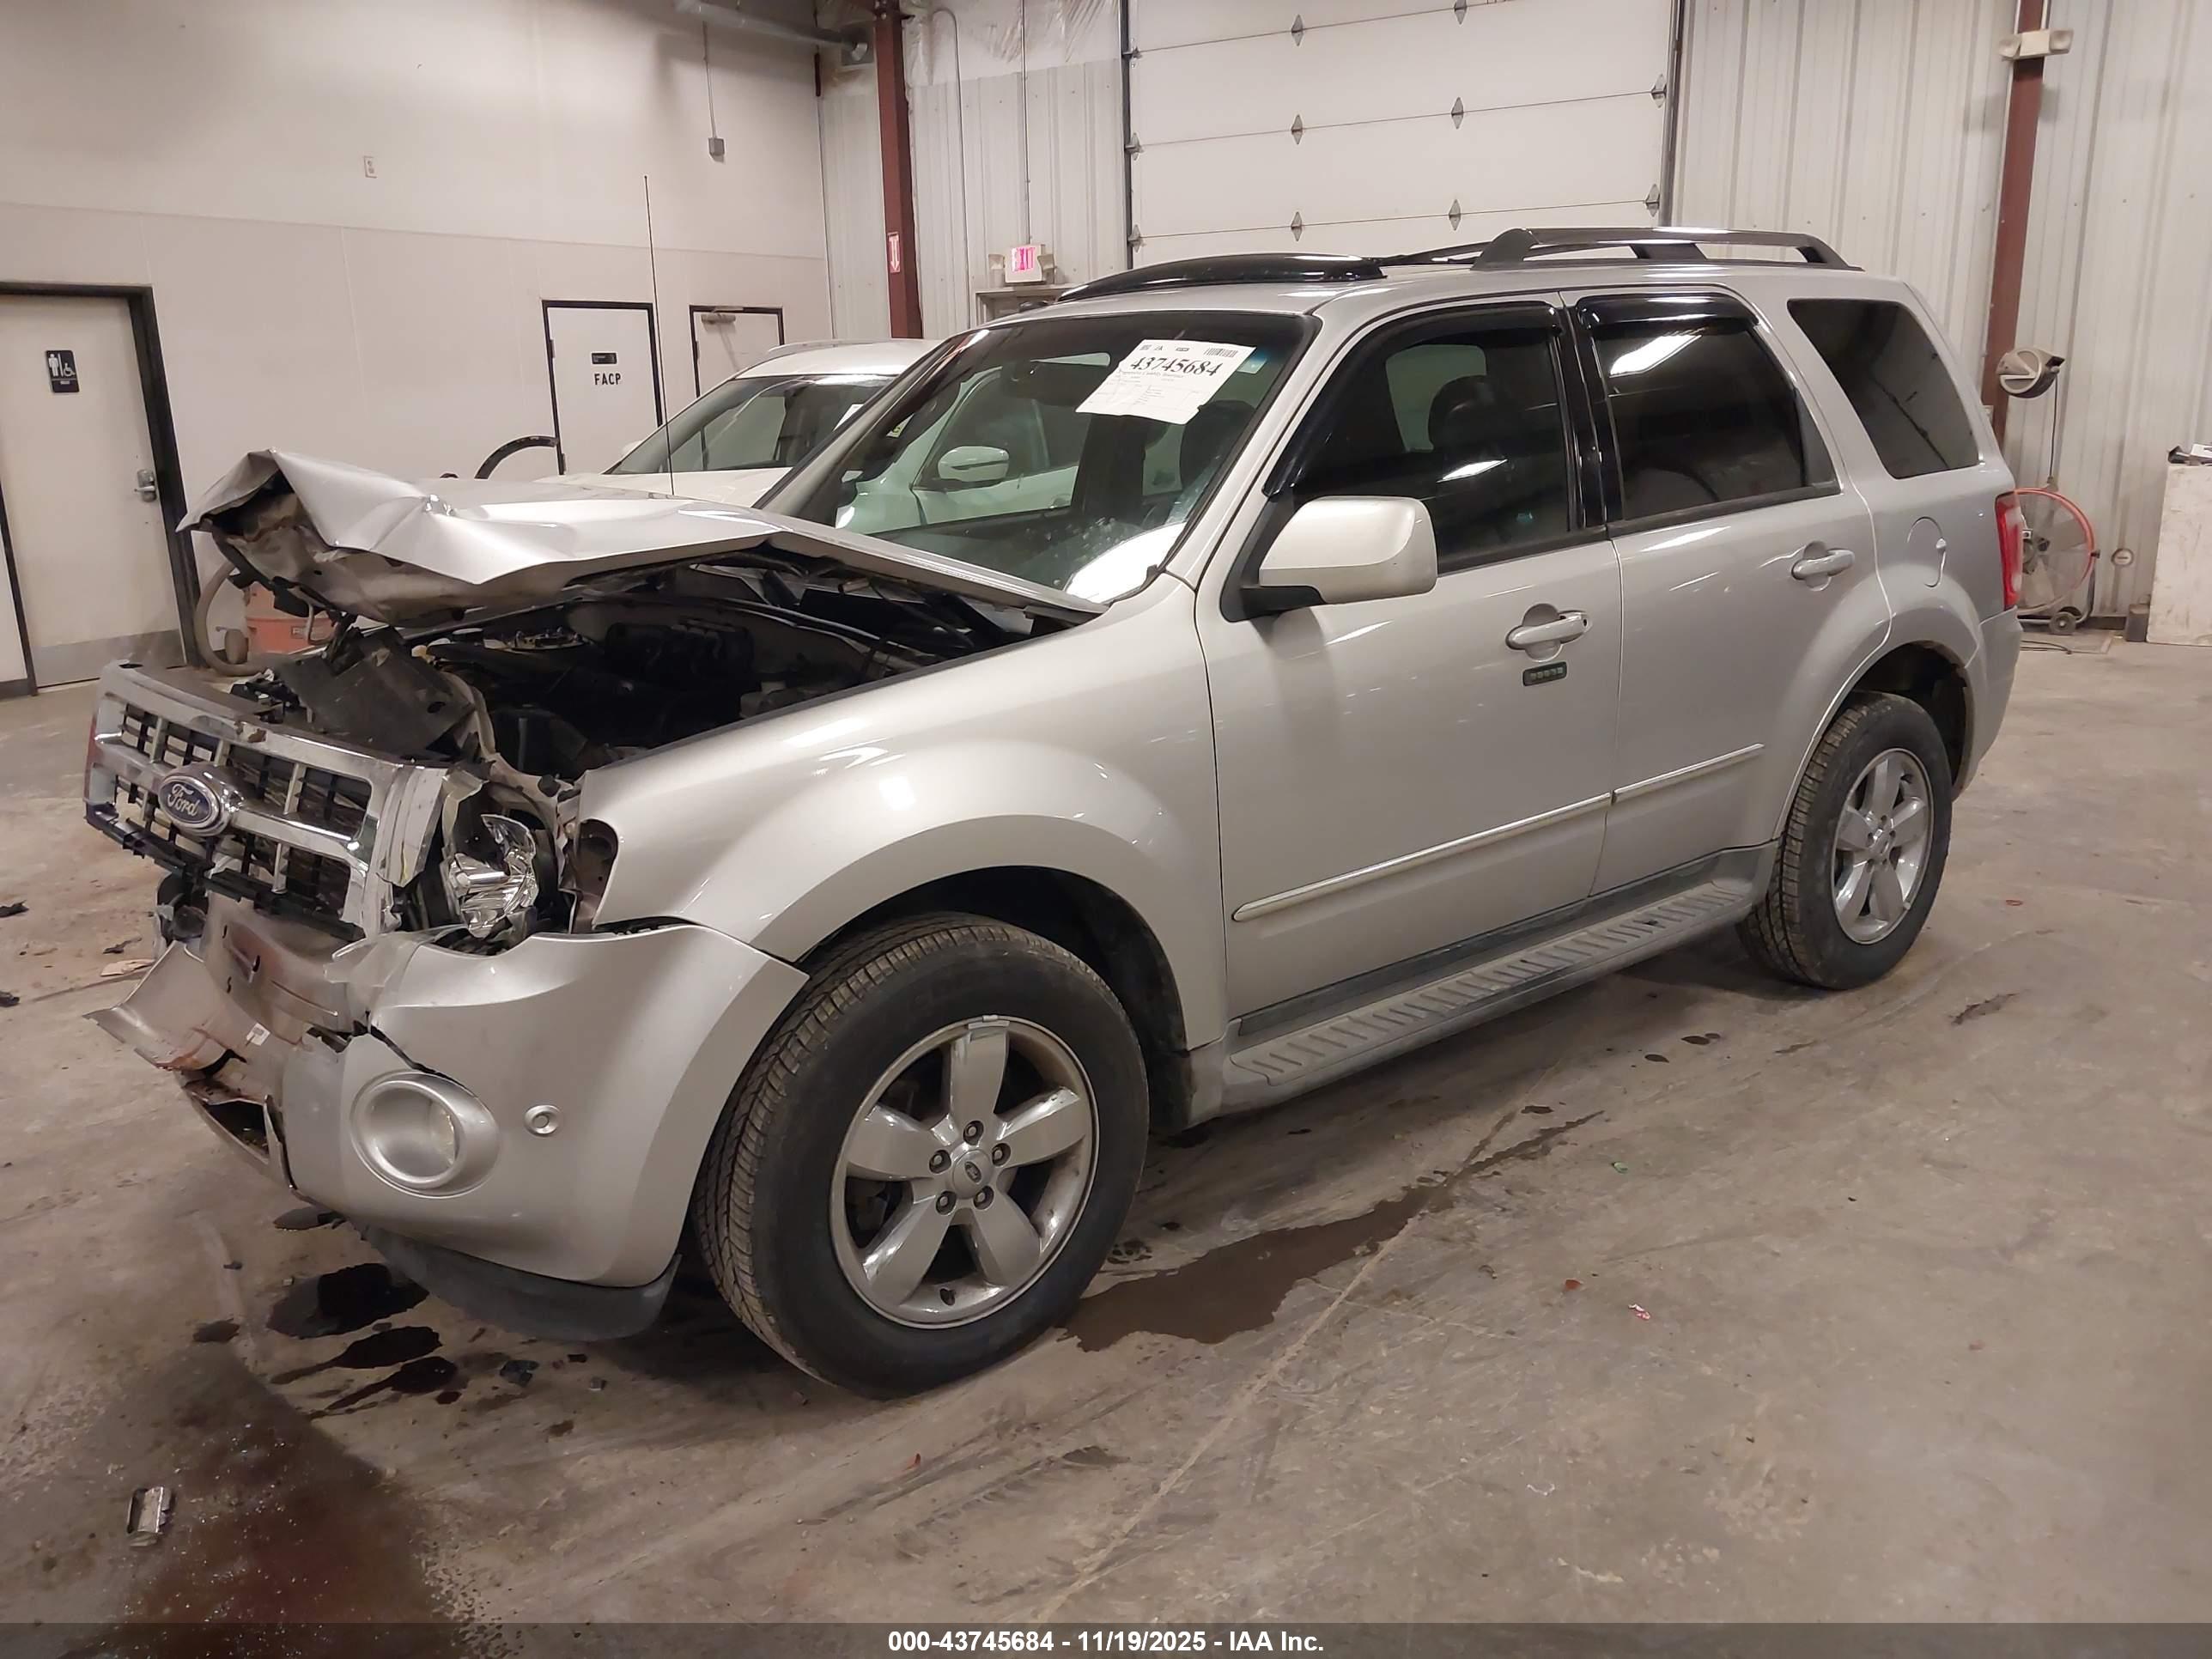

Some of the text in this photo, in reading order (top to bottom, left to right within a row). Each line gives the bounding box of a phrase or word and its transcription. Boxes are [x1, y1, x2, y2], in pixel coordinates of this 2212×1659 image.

[1012, 246, 1036, 271] EXIT
[1130, 356, 1224, 376] 43745684
[594, 373, 621, 386] FACP
[167, 783, 201, 817] Ford
